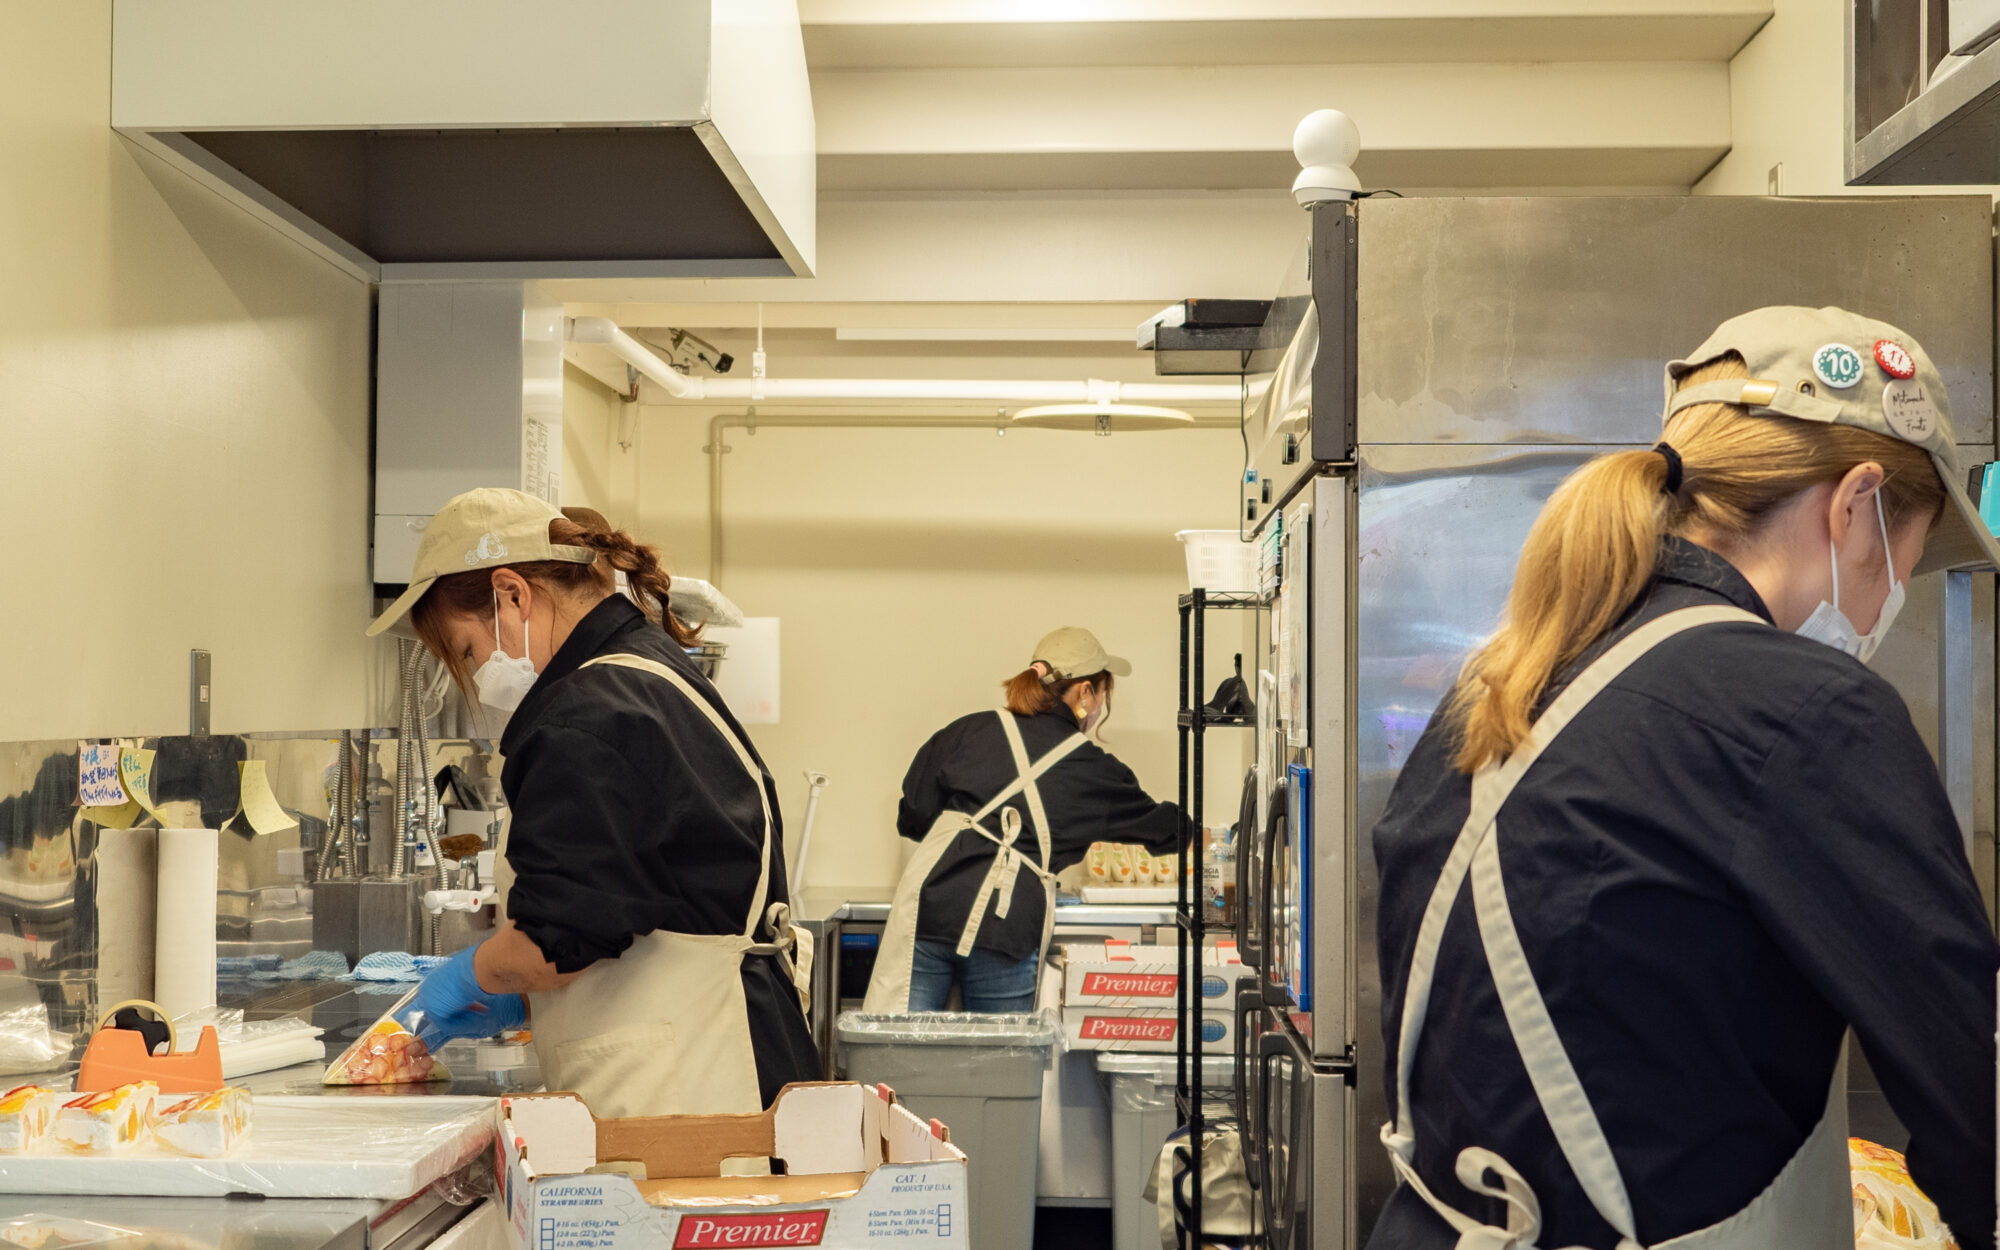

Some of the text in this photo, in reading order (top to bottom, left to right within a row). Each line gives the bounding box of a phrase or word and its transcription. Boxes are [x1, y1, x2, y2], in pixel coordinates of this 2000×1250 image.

[1826, 352, 1853, 375] 10
[1092, 975, 1172, 994] Premier
[1090, 1019, 1170, 1039] Premier
[540, 1187, 602, 1196] CALIFORNIA
[689, 1217, 817, 1244] Premier
